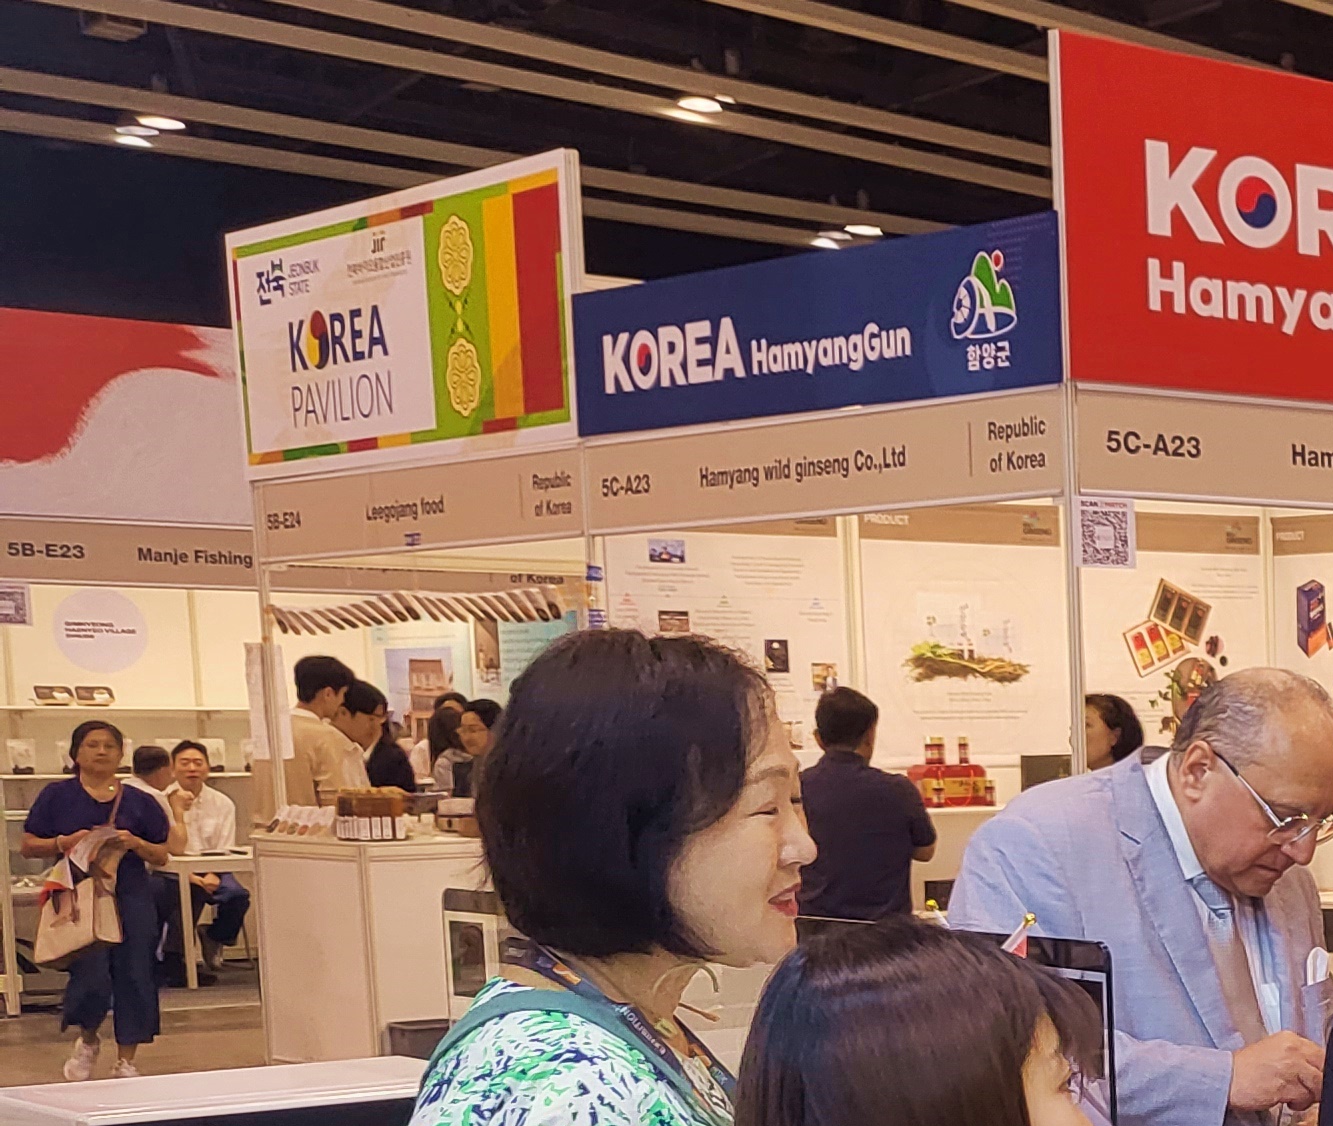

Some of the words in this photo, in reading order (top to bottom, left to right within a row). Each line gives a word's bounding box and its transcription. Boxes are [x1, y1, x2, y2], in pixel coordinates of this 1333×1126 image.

[289, 278, 310, 295] STATE
[288, 304, 389, 372] KOREA
[602, 316, 747, 395] KOREA
[751, 322, 912, 376] HamyangGun
[966, 341, 1012, 371] 함양군
[291, 369, 393, 428] PAVILION
[987, 416, 1047, 441] Republic
[1105, 429, 1202, 459] 5C-A23
[699, 462, 760, 489] Hamyang
[763, 458, 791, 482] wild
[794, 454, 850, 483] ginseng
[853, 445, 907, 472] Co.,Ltd
[989, 456, 1004, 473] of
[1006, 450, 1047, 472] Korea
[532, 472, 571, 489] Republic
[602, 474, 651, 497] 5C-A23
[366, 500, 418, 523] Leegojang
[420, 496, 444, 515] food
[534, 503, 545, 517] of
[546, 499, 572, 515] Korea
[864, 513, 910, 526] PRODUCT
[267, 512, 301, 530] 5B-E24
[7, 541, 85, 559] 5B-E23
[137, 548, 189, 566] Manje
[193, 549, 253, 568] Fishing
